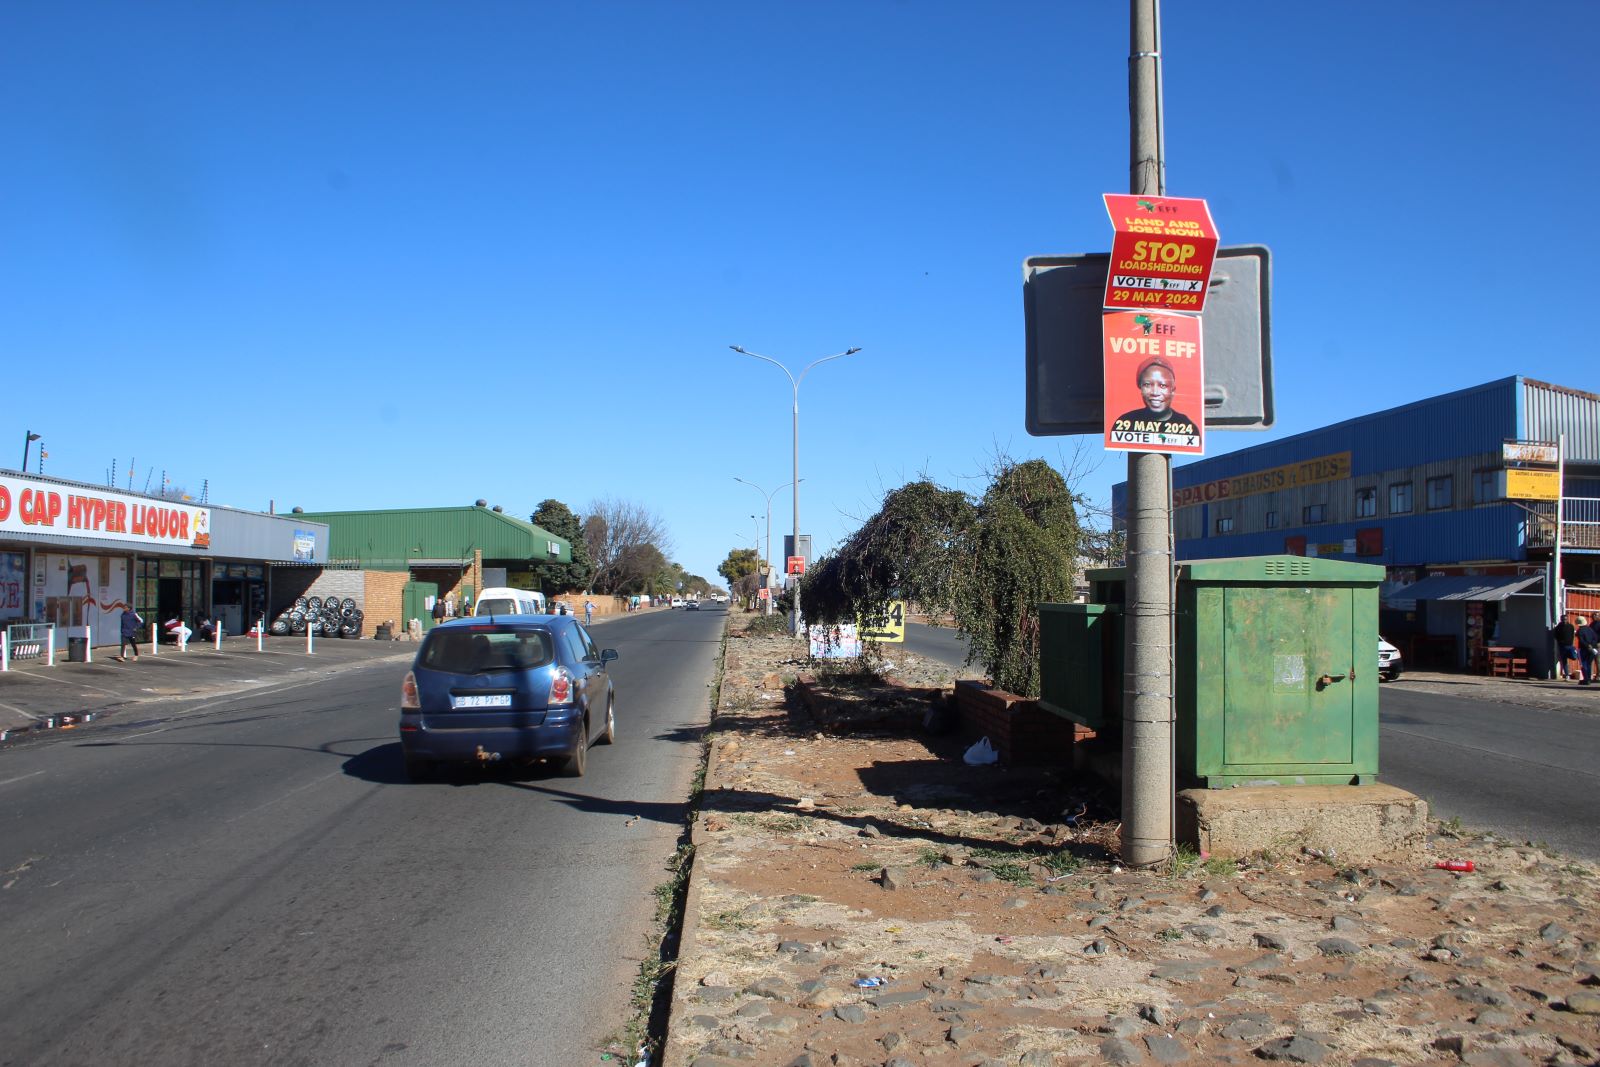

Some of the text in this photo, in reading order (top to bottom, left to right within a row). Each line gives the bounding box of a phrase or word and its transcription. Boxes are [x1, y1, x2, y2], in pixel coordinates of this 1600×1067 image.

[1125, 217, 1200, 229] LAND AND
[1128, 225, 1205, 237] JOBS NOW!
[1132, 241, 1196, 263] STOP
[1120, 260, 1203, 274] LOADSHEDDING!
[1117, 276, 1152, 288] VOTE
[1188, 281, 1198, 290] X
[1113, 291, 1197, 304] 29 MAY 2024
[1156, 323, 1176, 335] EFF
[1109, 337, 1196, 359] VOTE EFF
[1115, 420, 1193, 434] 29 MAY 2024
[1115, 432, 1150, 443] VOTE
[1186, 436, 1195, 446] X
[1300, 459, 1338, 482] TYRES
[19, 488, 62, 526] CAP
[67, 494, 127, 534] HYPER
[131, 503, 189, 540] LIQUOR
[890, 603, 902, 626] 4
